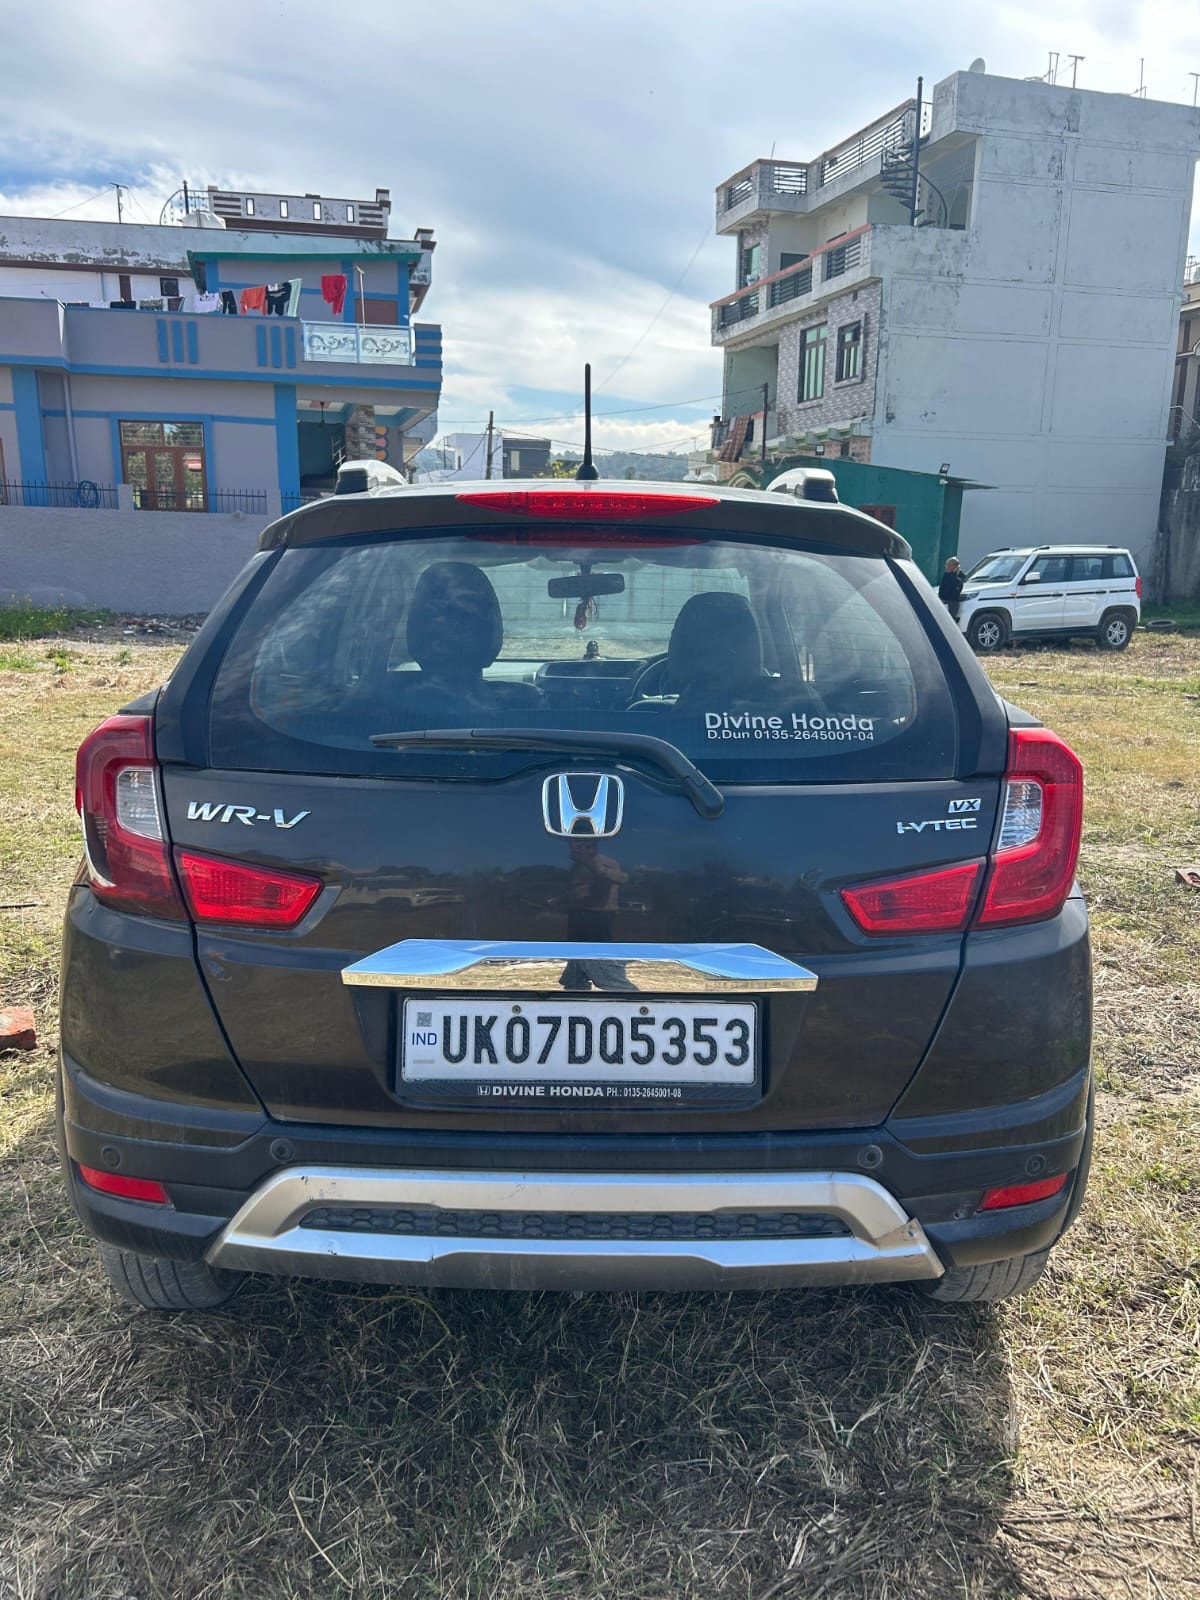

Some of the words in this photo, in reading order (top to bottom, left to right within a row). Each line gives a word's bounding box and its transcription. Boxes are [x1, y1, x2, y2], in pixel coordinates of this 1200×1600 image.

[705, 711, 783, 729] Divine
[791, 712, 874, 731] Honda
[707, 729, 750, 740] D.Dun
[754, 730, 874, 741] 0135-2645001-04
[952, 799, 978, 812] VX
[186, 801, 312, 829] WR-V
[411, 1032, 437, 1046] IND
[442, 1014, 750, 1067] UK07DQ5353
[492, 1086, 545, 1097] DIVINE
[549, 1086, 604, 1097] HONDA
